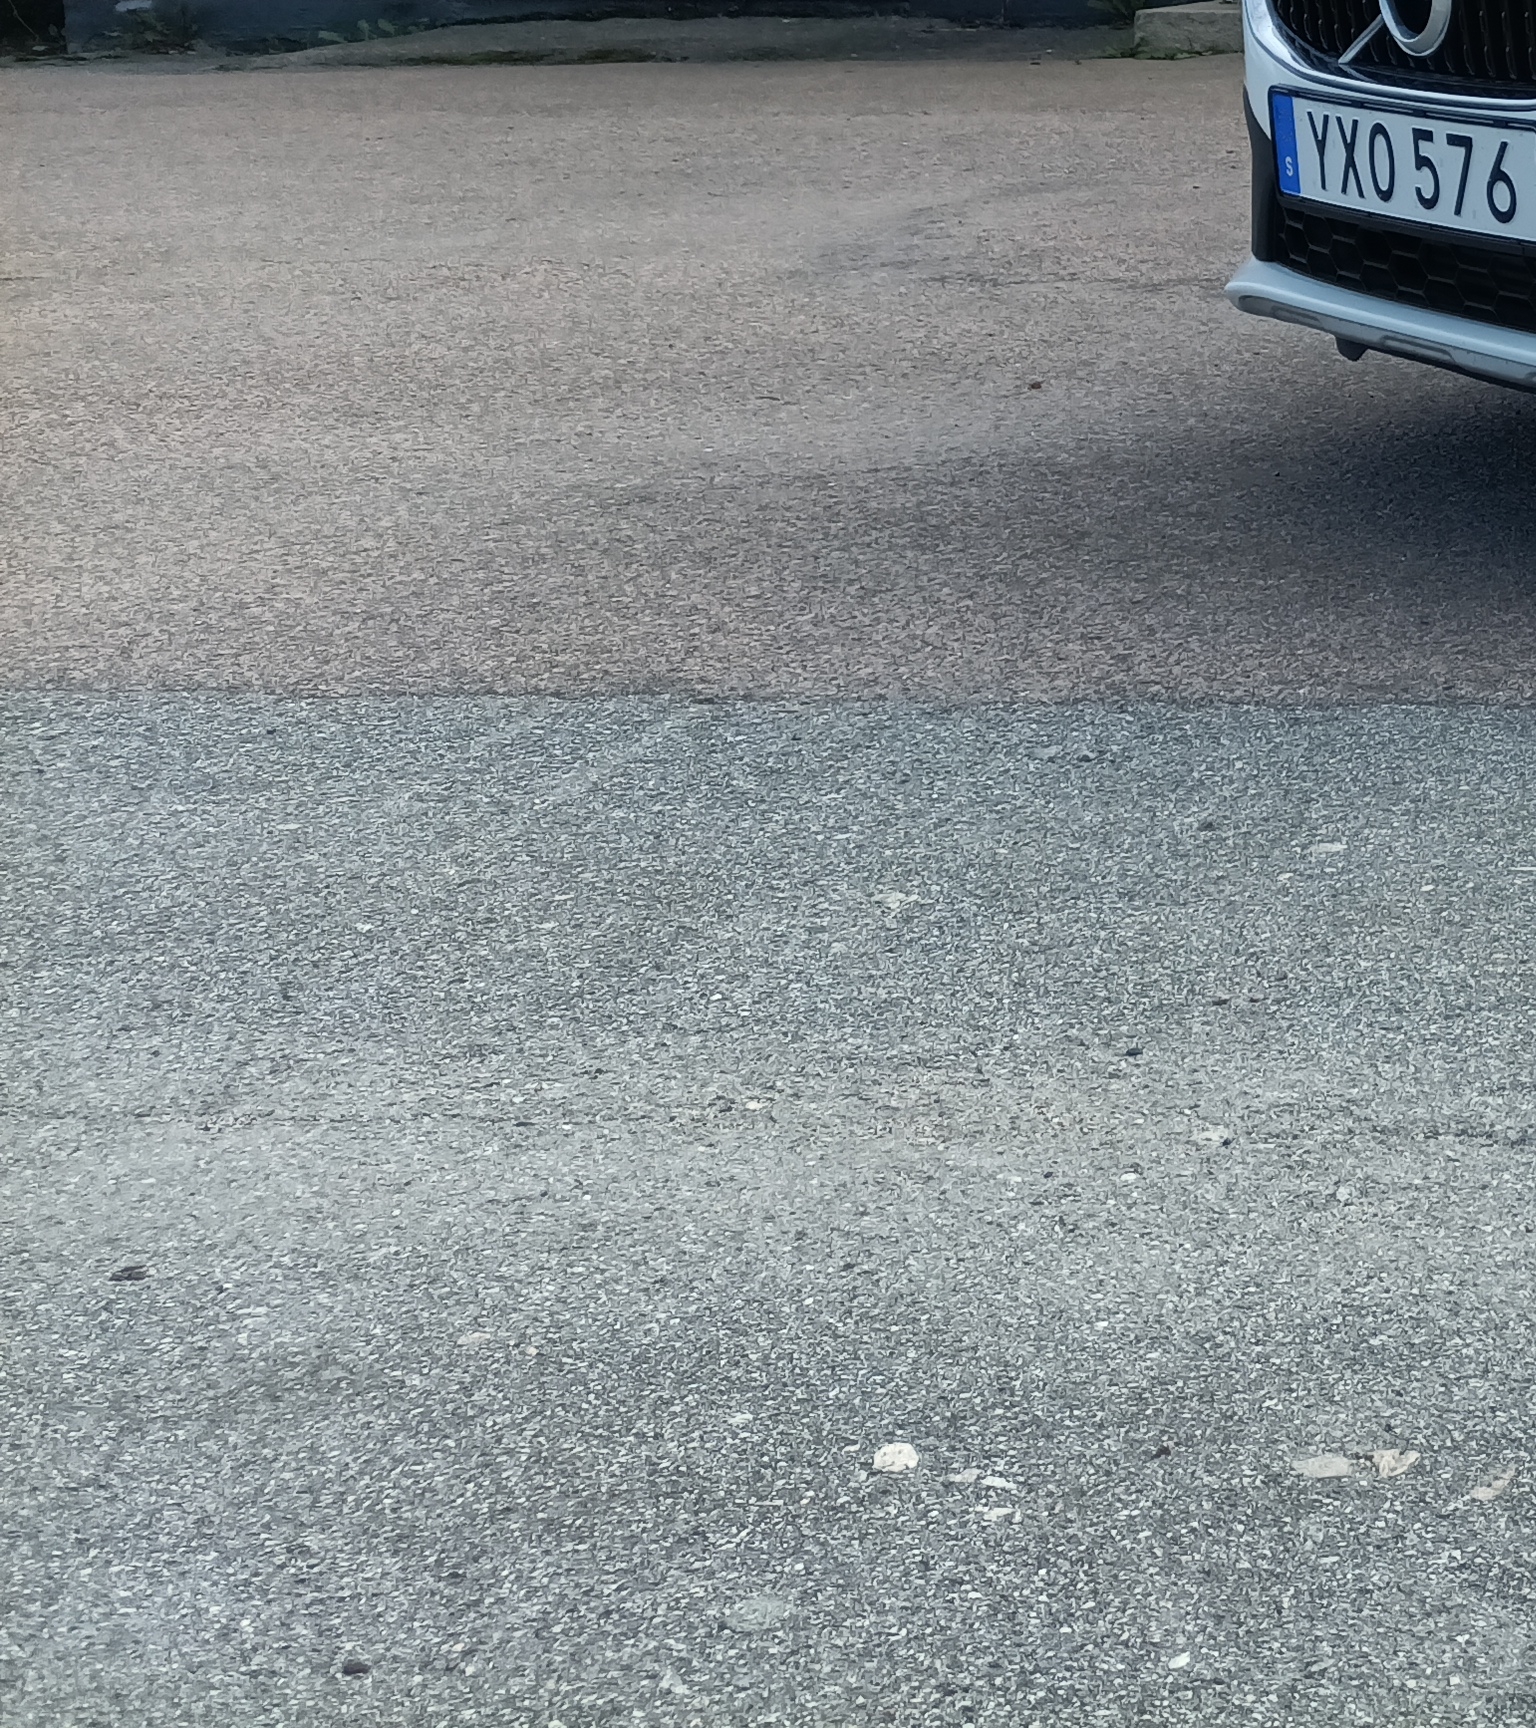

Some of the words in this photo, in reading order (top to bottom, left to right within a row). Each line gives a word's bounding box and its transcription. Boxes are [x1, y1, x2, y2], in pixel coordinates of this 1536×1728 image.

[1284, 156, 1294, 177] S
[1306, 110, 1396, 203] YXO
[1411, 127, 1518, 224] 576
